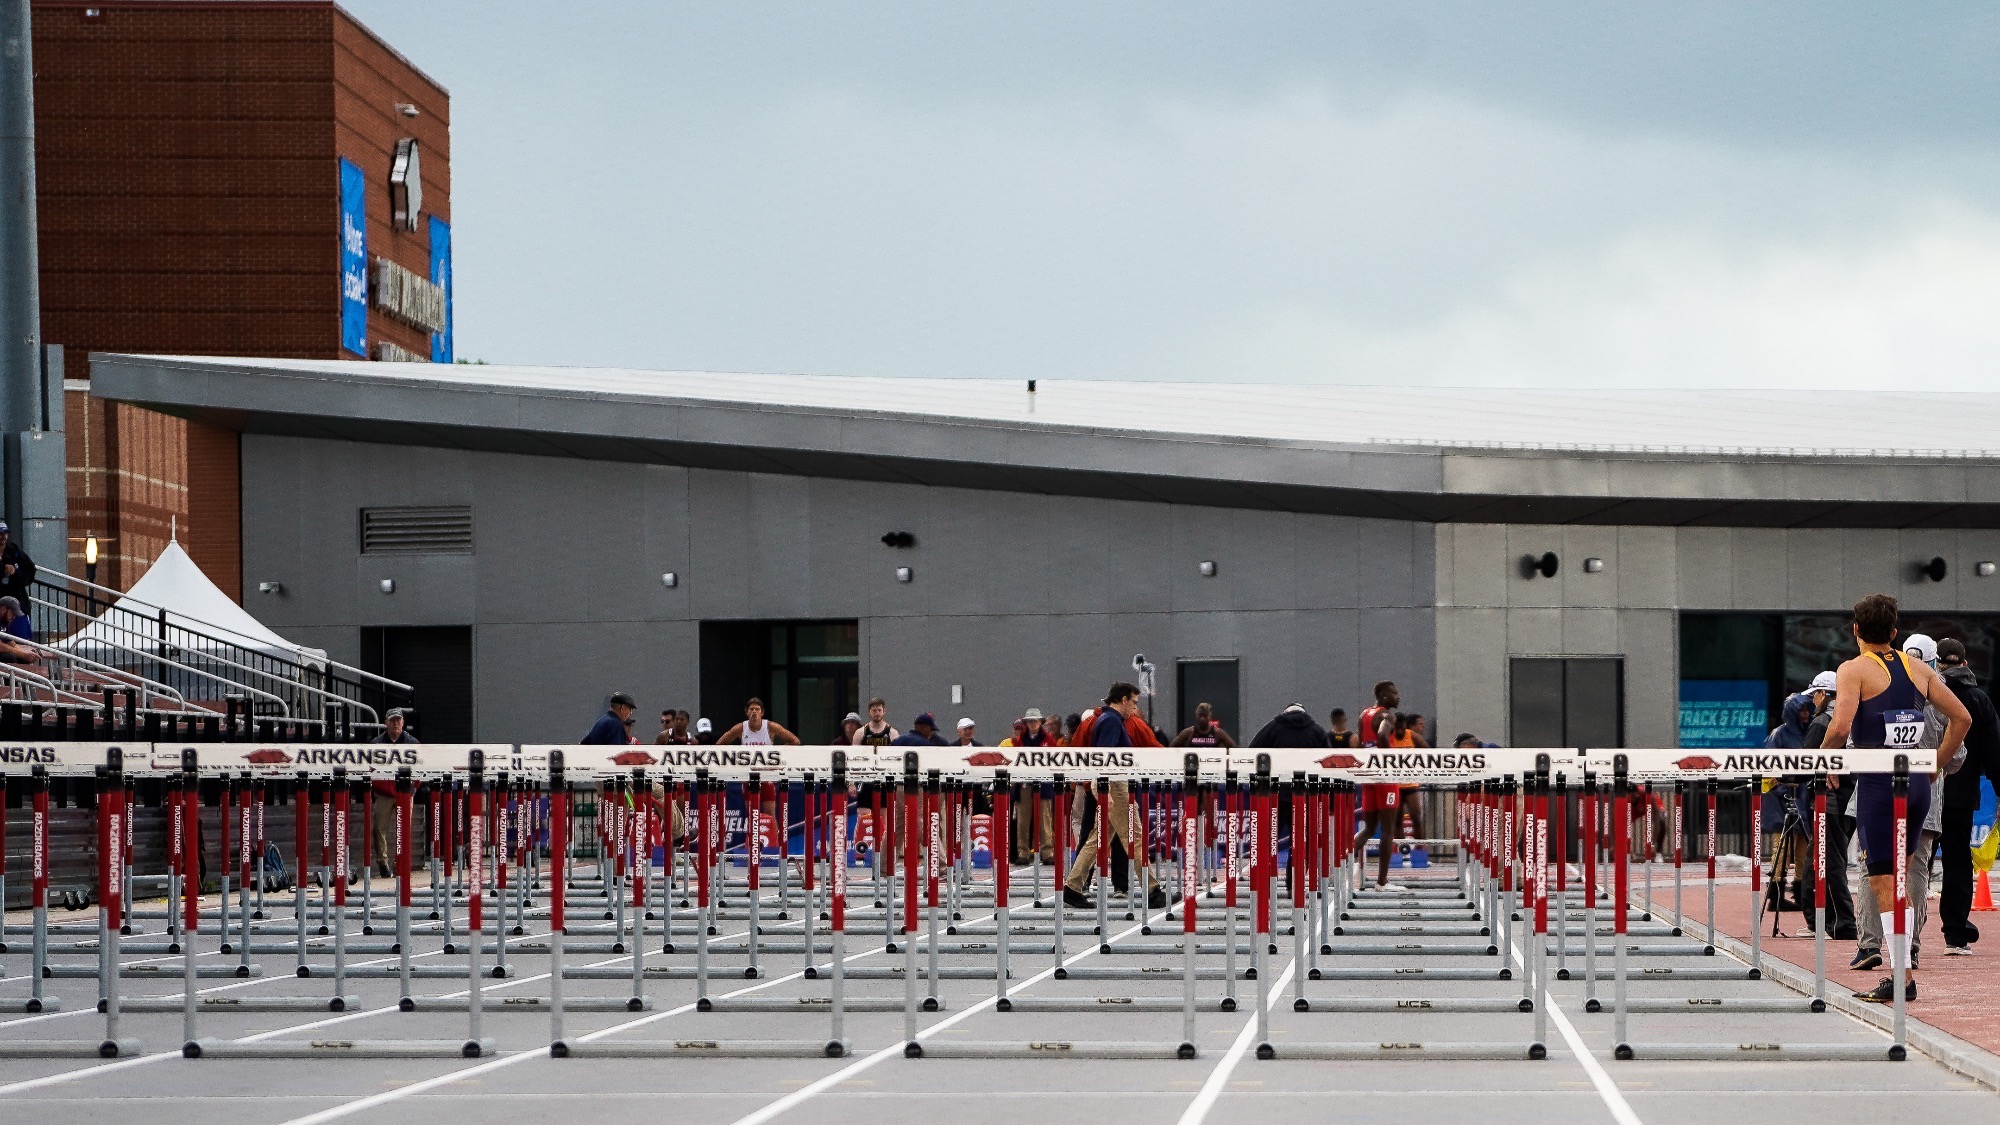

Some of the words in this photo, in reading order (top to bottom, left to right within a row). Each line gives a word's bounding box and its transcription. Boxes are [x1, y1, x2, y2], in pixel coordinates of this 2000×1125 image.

[1680, 710, 1718, 726] TRACK
[1730, 710, 1766, 726] FIELD
[1894, 726, 1916, 744] 322
[296, 748, 417, 764] ARKANSAS
[660, 750, 780, 766] ARKANSAS
[1015, 752, 1134, 766] ARKANSAS
[1367, 754, 1485, 768] ARKANSAS
[1724, 755, 1843, 770] ARKANSAS
[1389, 794, 1394, 804] 6
[34, 812, 42, 878] RAZORBACKS
[109, 814, 120, 894] RAZORBACKS
[336, 811, 345, 876] RAZORBACKS
[470, 816, 481, 894] RAZORBACKS
[835, 815, 845, 894] RAZORBACKS
[931, 812, 939, 877] RAZORBACKS
[1185, 818, 1196, 896] RAZORBACKS
[1228, 813, 1237, 877] RAZORBACKS
[1537, 819, 1547, 897] RAZORBACKS
[1897, 818, 1906, 898] RAZORBACKS
